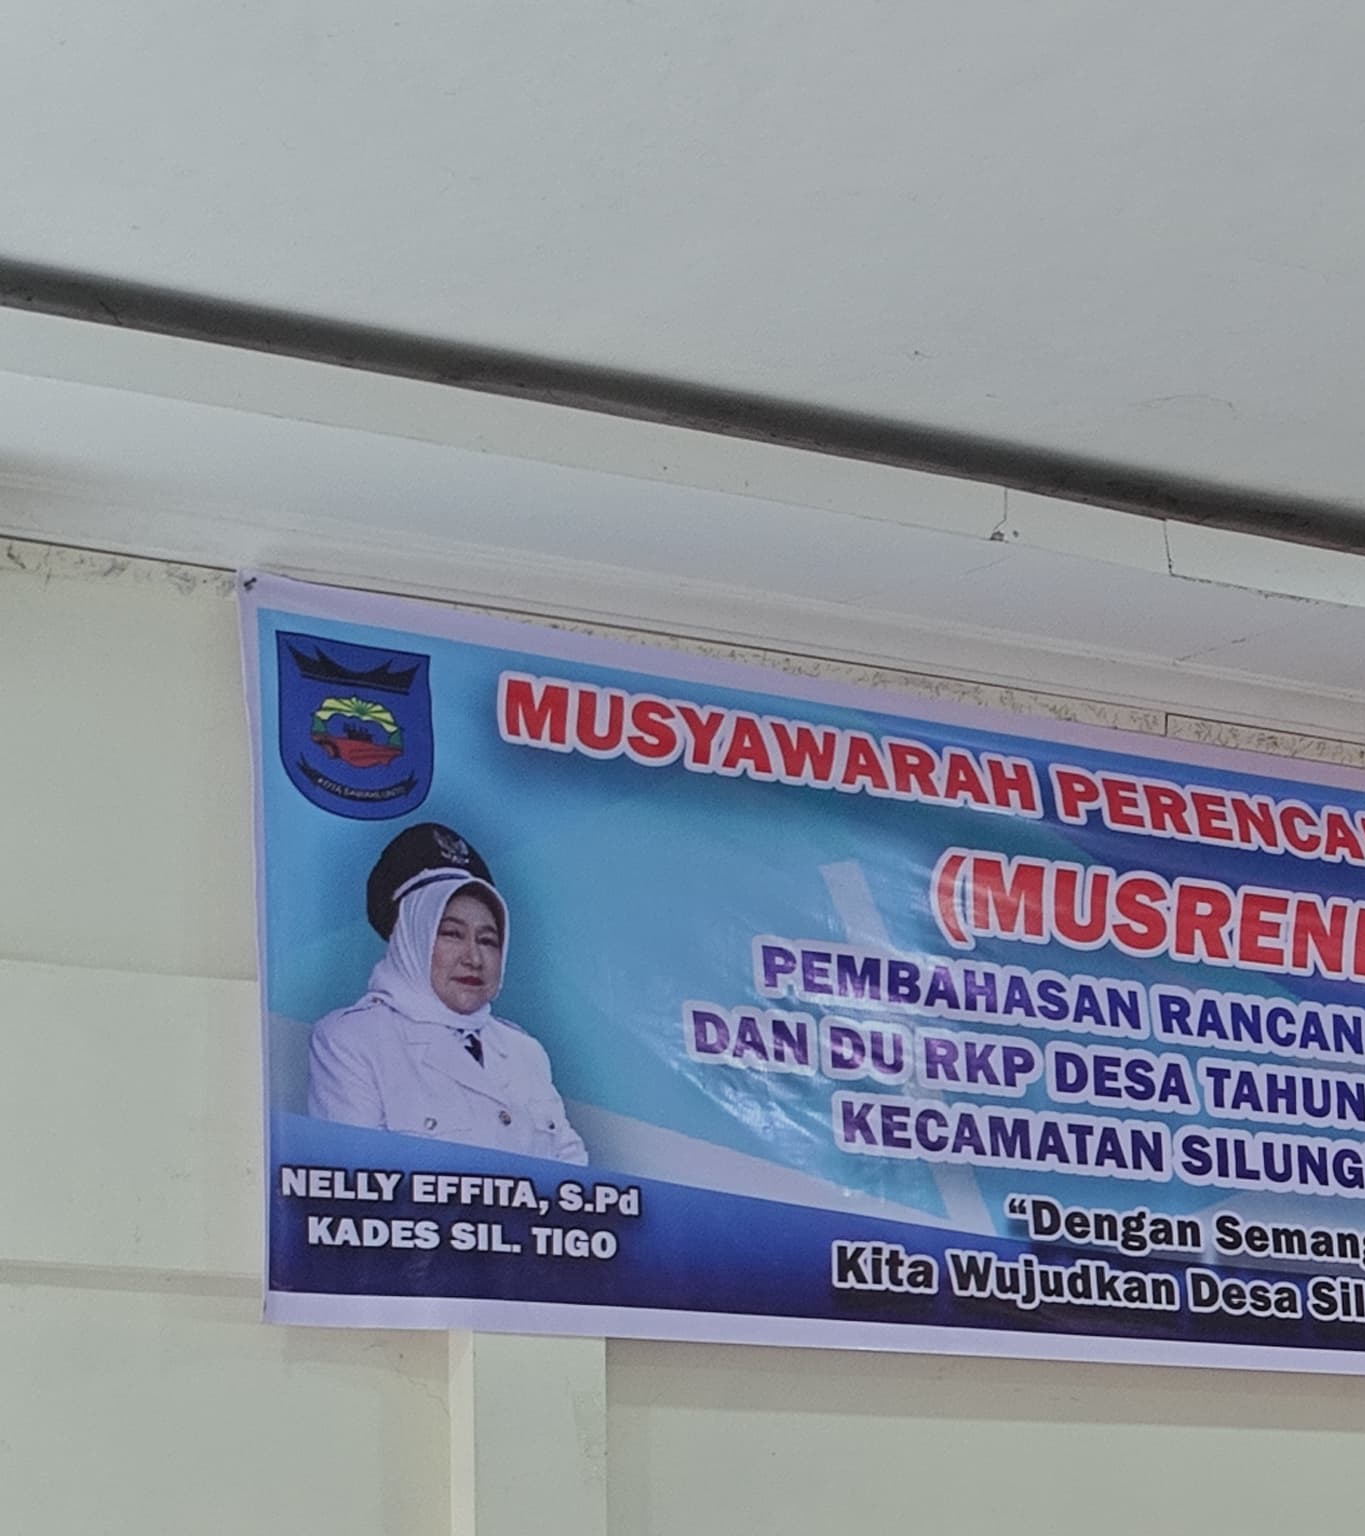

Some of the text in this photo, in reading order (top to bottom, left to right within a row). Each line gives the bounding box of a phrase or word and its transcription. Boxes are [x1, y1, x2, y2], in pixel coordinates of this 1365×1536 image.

[502, 678, 1036, 814] MUSYAWARAH
[762, 944, 1141, 1029] PEMBAHASAN
[691, 1011, 810, 1067] DAN
[829, 1025, 905, 1073] DU
[925, 1037, 1035, 1088] RKP
[1055, 1050, 1189, 1105] DESA
[1207, 1064, 1365, 1122] TAHUN
[841, 1101, 1164, 1173] KECAMATAN
[280, 1166, 641, 1217] NELLY EFFITA, S.Pd
[306, 1217, 617, 1259] KADES SIL. TIGO
[834, 1245, 934, 1292] Kita
[950, 1252, 1175, 1312] Wujudkan
[1190, 1270, 1300, 1318] Desa
